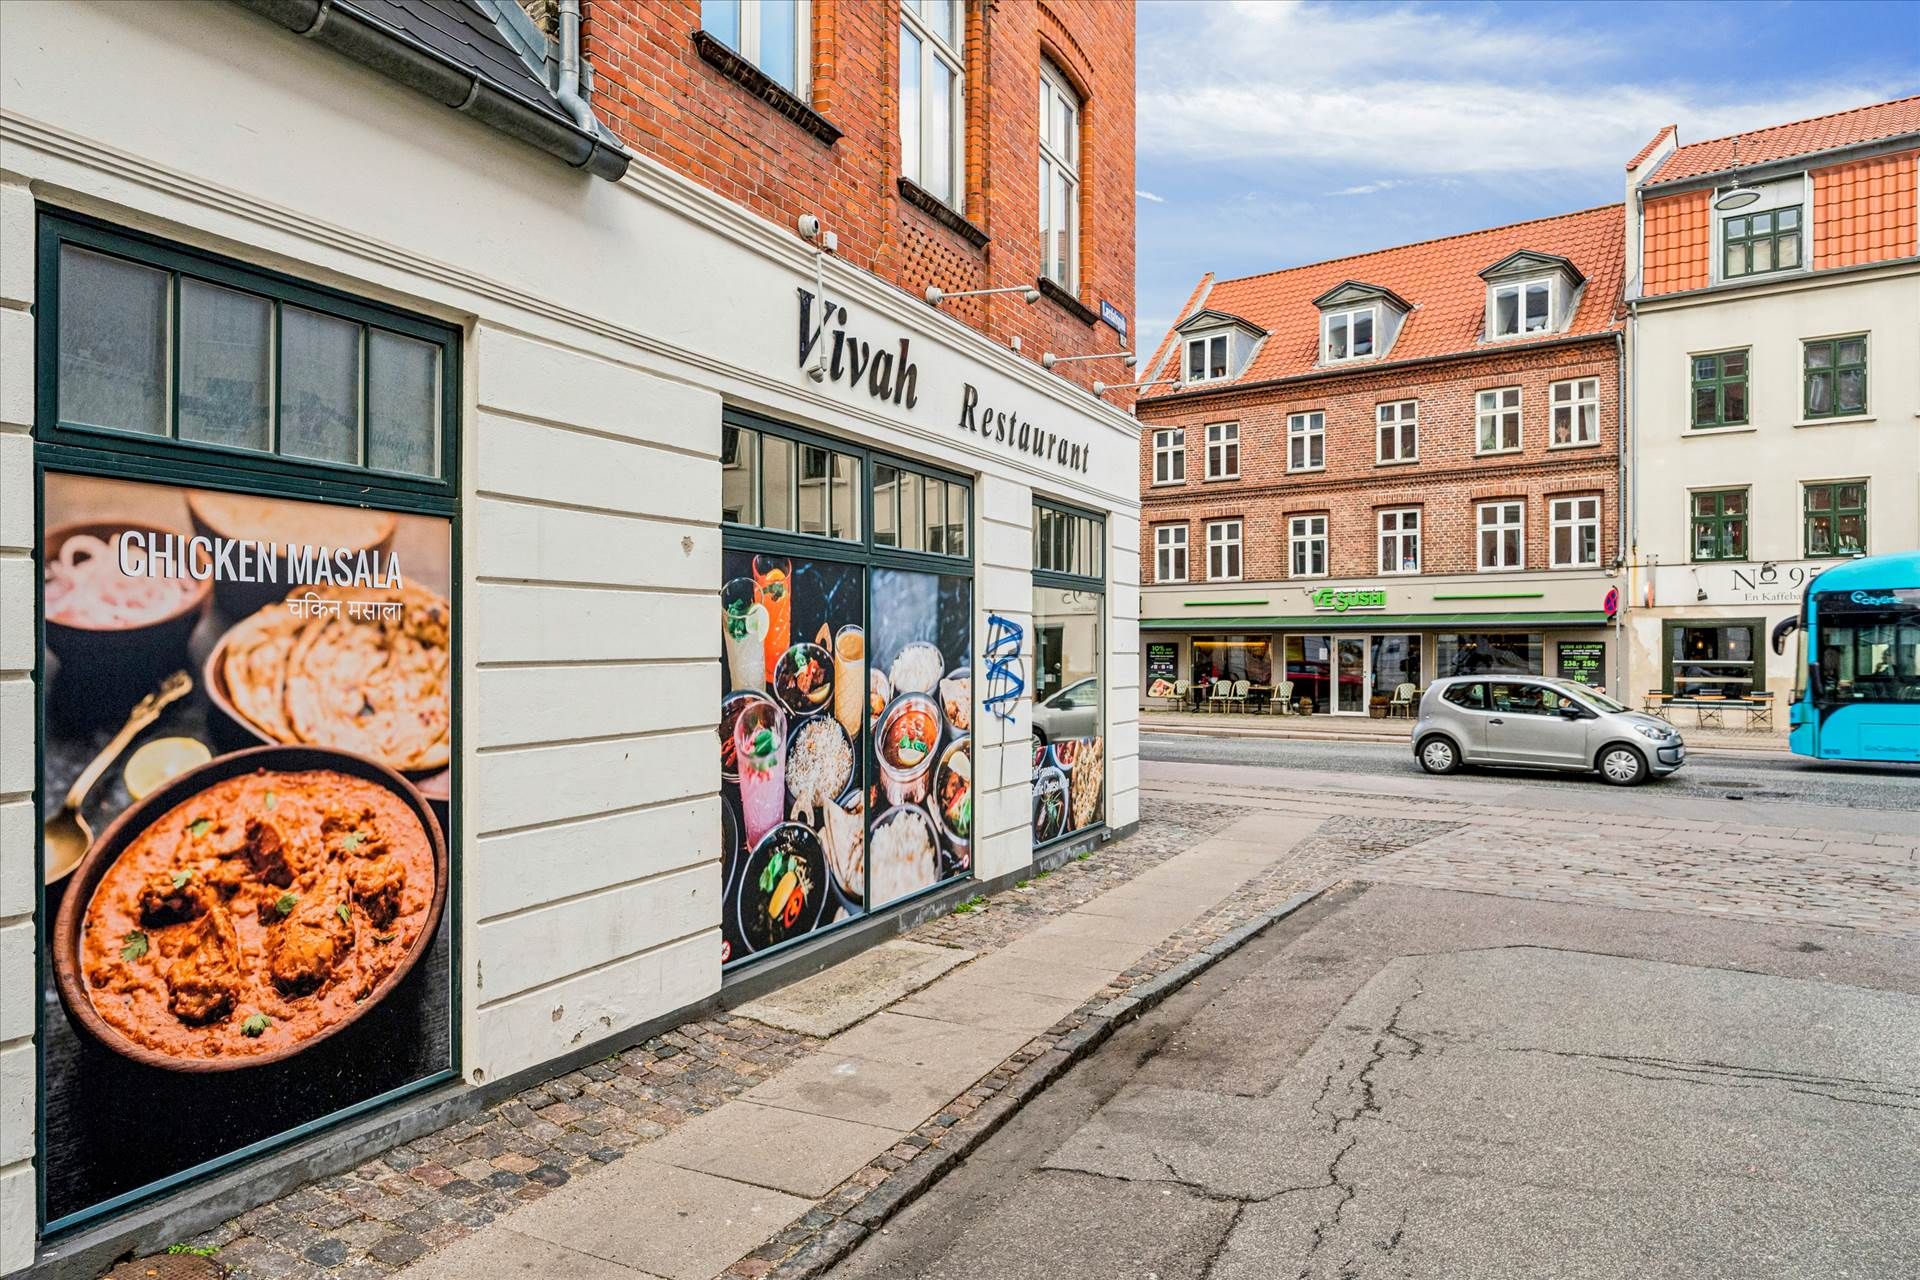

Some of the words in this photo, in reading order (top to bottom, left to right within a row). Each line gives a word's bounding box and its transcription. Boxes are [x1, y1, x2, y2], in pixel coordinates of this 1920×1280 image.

[797, 287, 919, 410] Vivah
[959, 382, 1090, 474] Restaurant
[119, 530, 277, 584] CHICKEN
[287, 543, 404, 590] MASALA
[347, 601, 404, 622] मसाला
[1745, 593, 1758, 601] En
